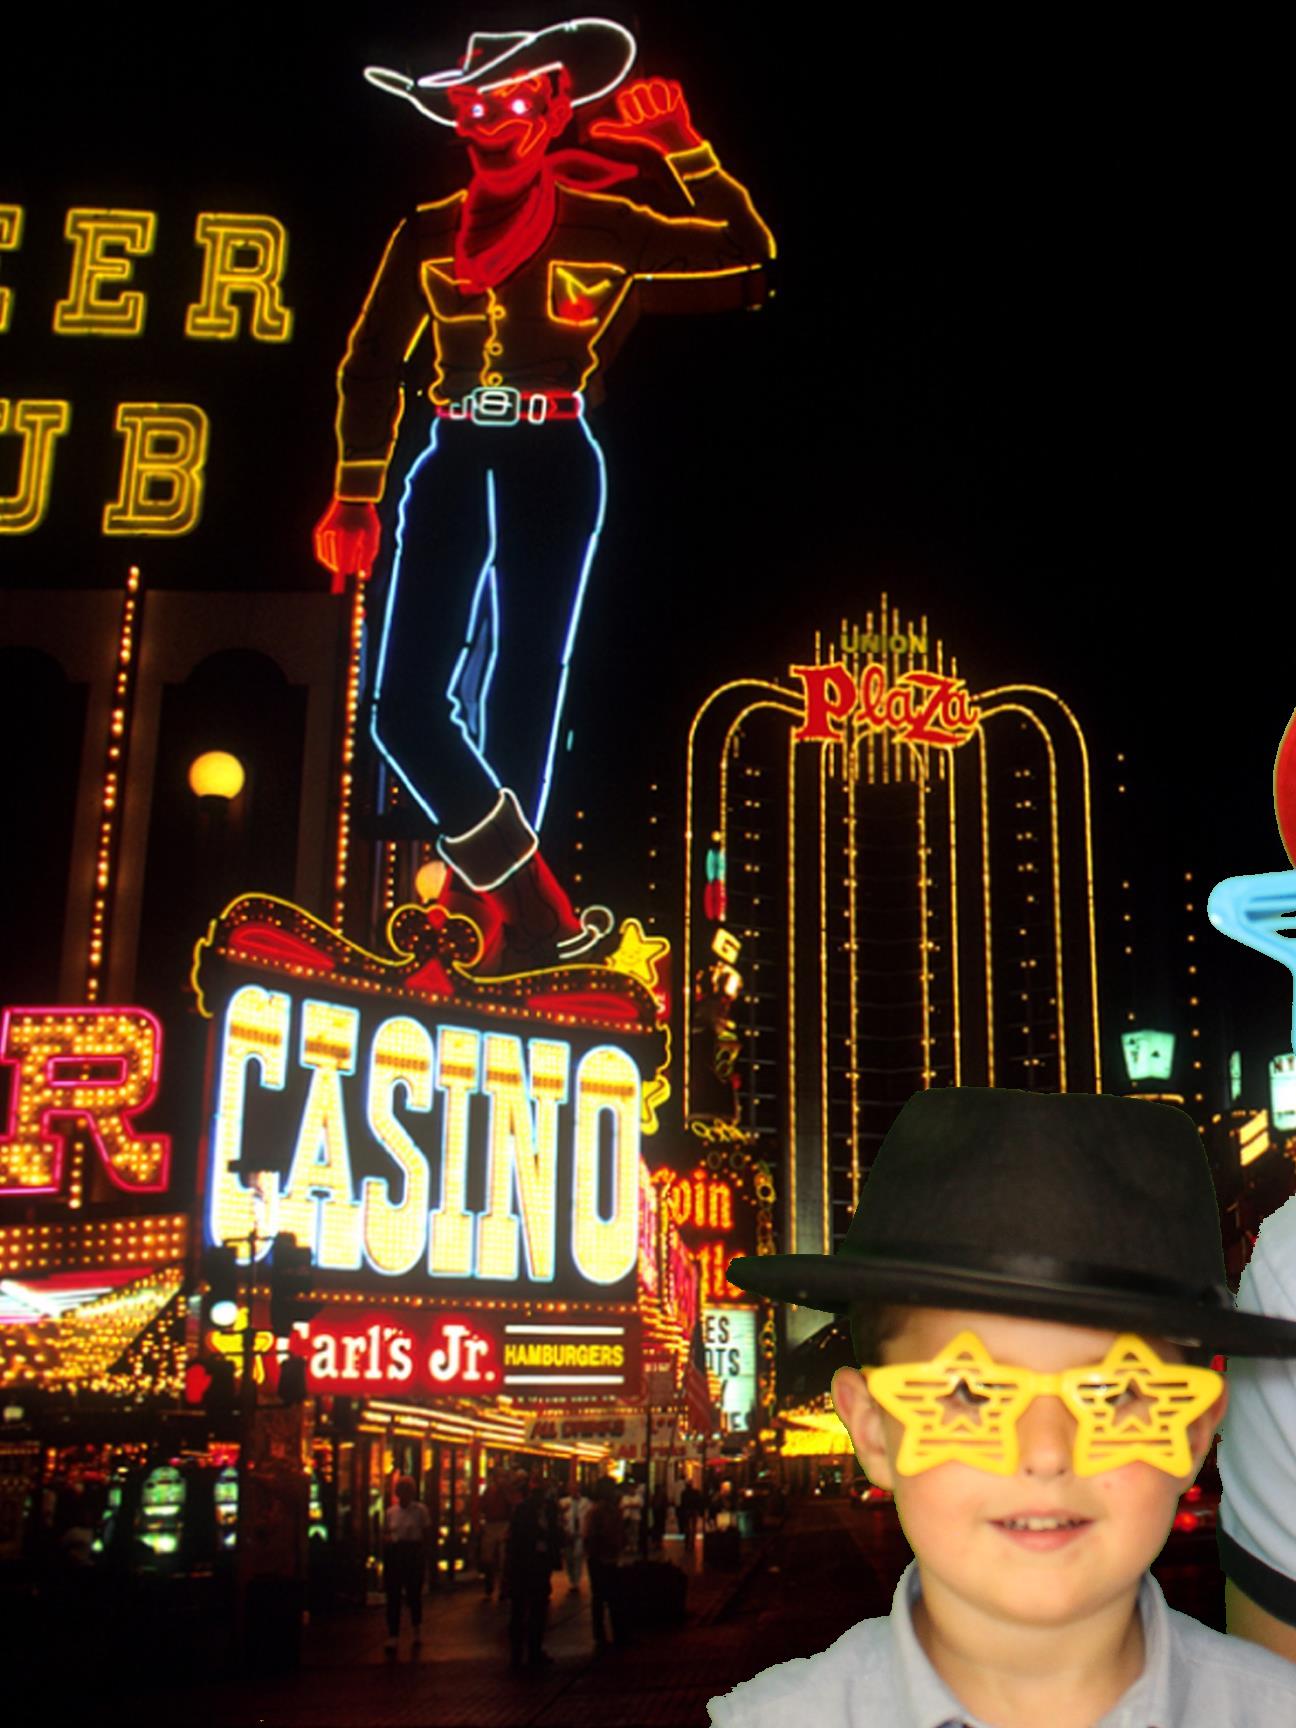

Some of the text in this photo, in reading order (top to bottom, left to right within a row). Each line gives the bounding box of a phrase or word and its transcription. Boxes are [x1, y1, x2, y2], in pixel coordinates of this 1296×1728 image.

[0, 204, 293, 342] ER
[209, 984, 641, 1284] CASINO
[429, 1324, 496, 1382] Jr.
[504, 1345, 624, 1367] HAMBURGERS
